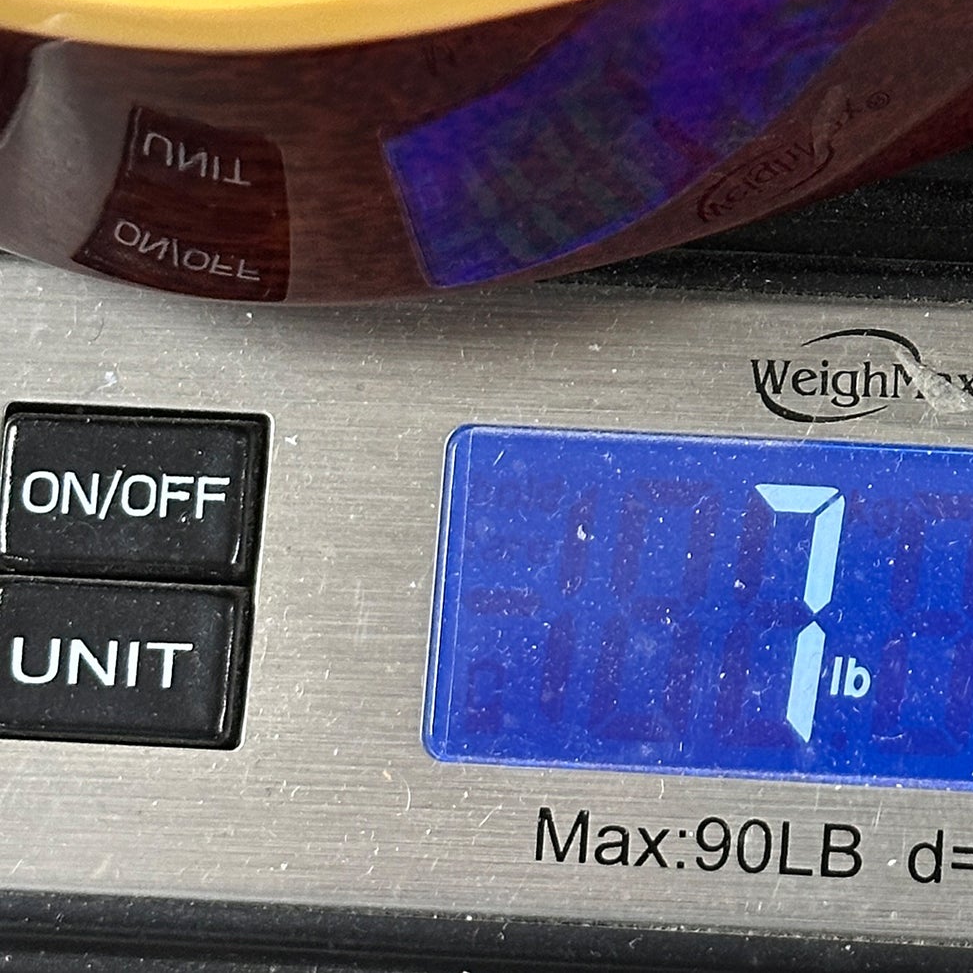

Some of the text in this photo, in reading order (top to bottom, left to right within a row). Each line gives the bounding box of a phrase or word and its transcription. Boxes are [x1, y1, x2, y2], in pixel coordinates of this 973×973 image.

[21, 470, 231, 519] ON/OFF
[754, 483, 846, 743] 7
[829, 655, 872, 699] lb
[11, 636, 194, 689] UNIT
[534, 806, 863, 879] Max:90LB
